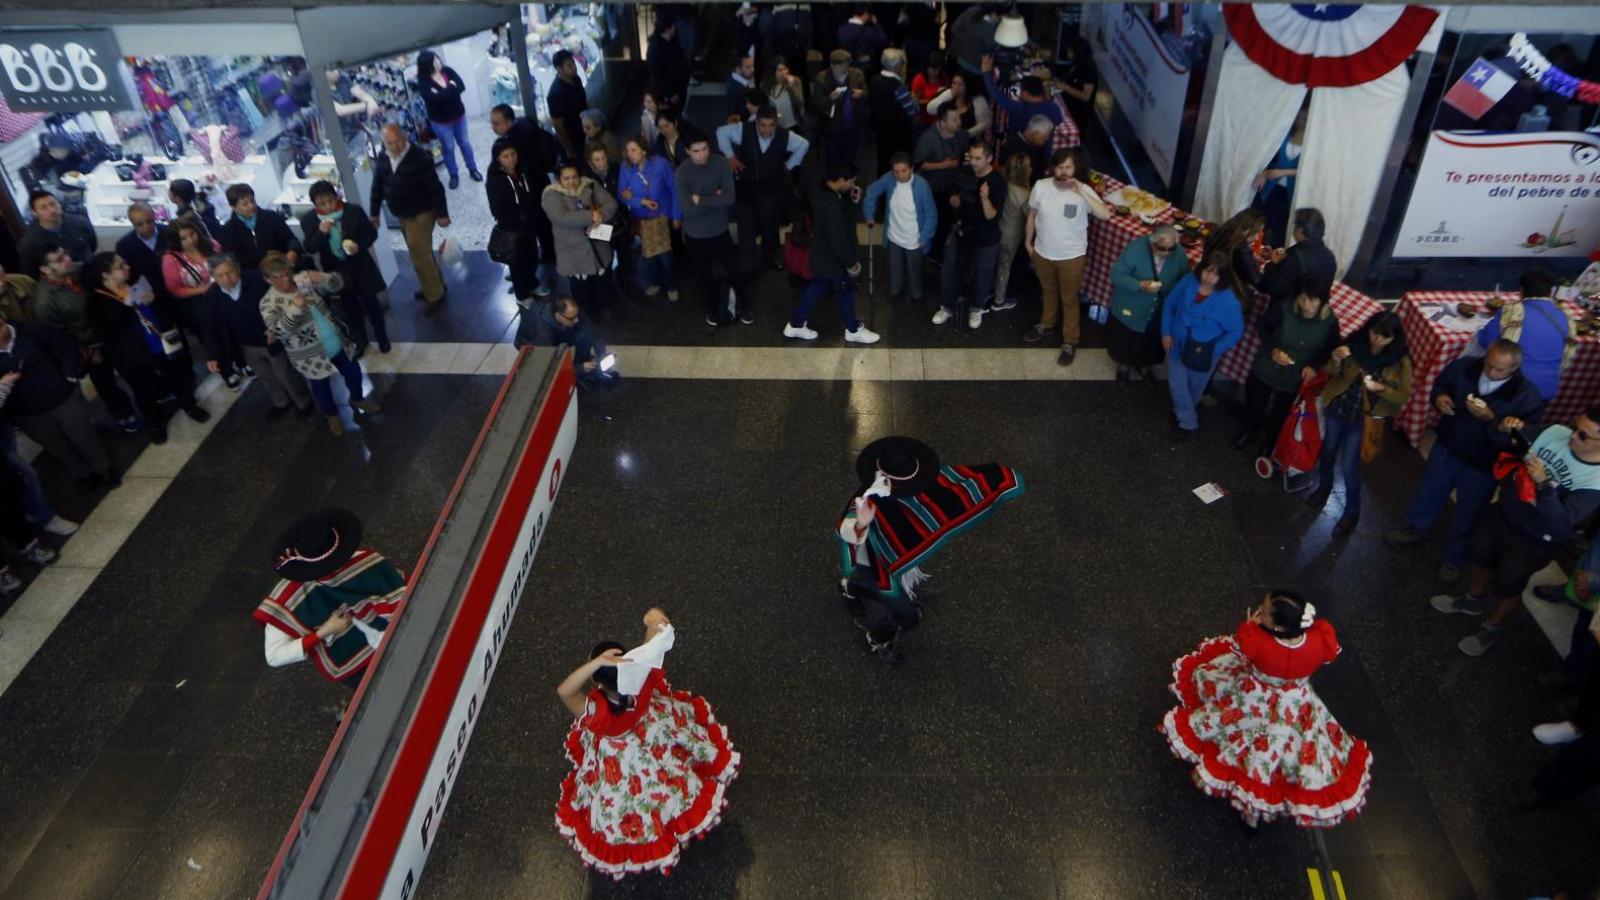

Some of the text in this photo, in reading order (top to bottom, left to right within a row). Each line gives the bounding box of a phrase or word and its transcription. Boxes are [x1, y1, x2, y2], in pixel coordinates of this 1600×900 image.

[1445, 171, 1462, 183] Te
[1466, 172, 1570, 185] presentamos
[1575, 174, 1585, 183] a
[1488, 187, 1513, 198] del
[1516, 187, 1565, 200] pebre
[1569, 187, 1590, 198] de
[1416, 235, 1460, 243] PEBRE
[421, 694, 477, 850] Paseo
[483, 511, 543, 685] Ahumada
